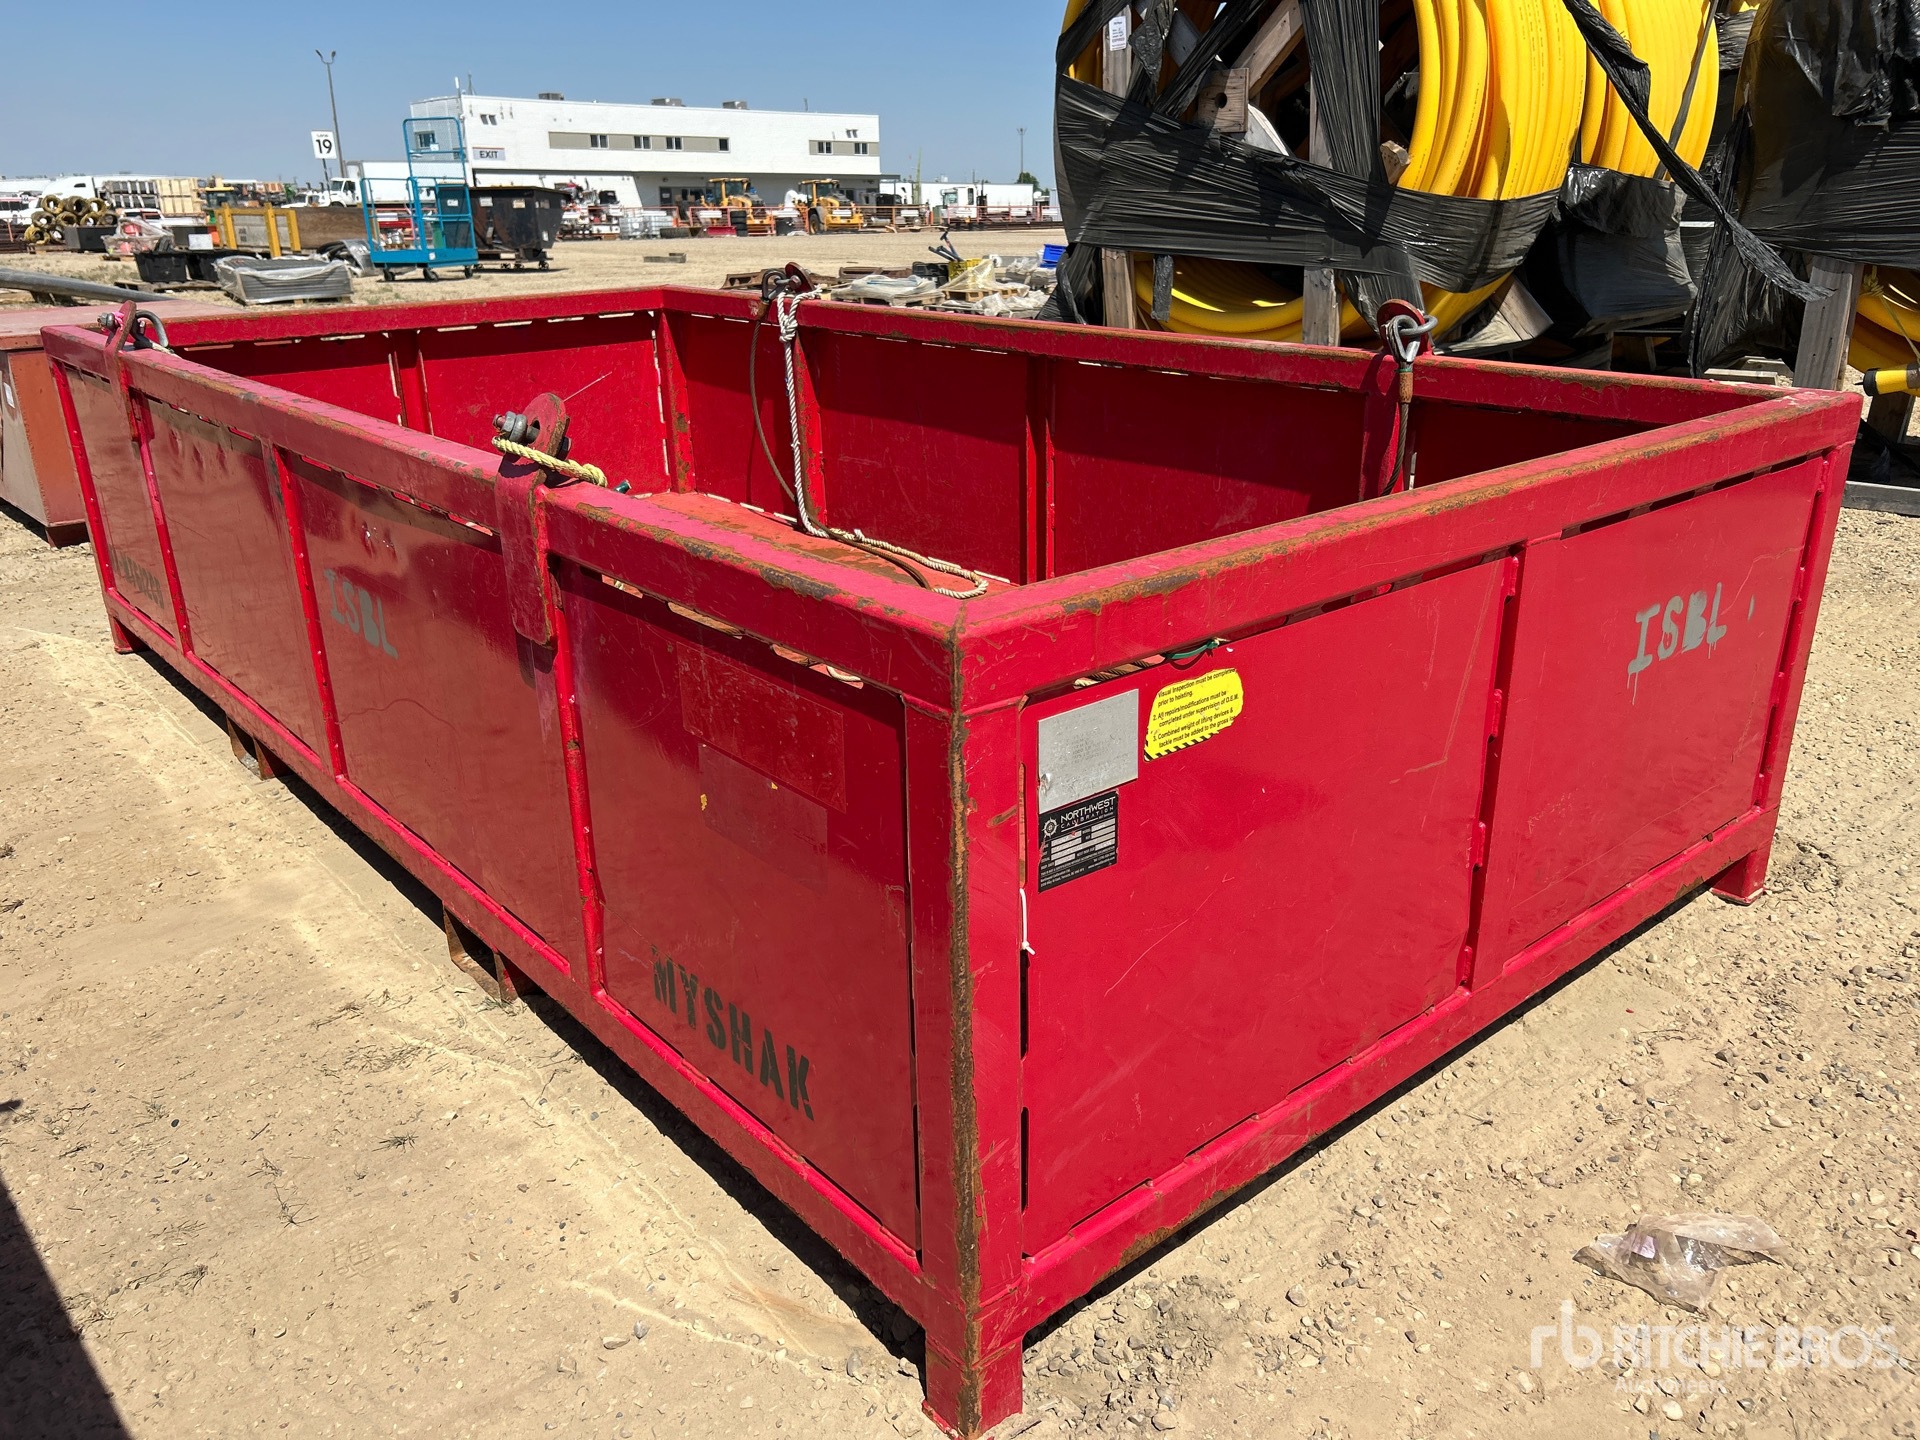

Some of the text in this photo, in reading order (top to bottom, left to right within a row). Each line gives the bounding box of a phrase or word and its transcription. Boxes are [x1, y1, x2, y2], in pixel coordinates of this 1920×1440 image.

[315, 139, 333, 154] 19
[479, 150, 499, 159] EXIT
[324, 568, 399, 660] ISBL
[1627, 582, 1727, 675] ISBL
[1158, 689, 1172, 698] Visual
[1195, 676, 1207, 684] must
[1158, 700, 1169, 708] prior
[1159, 714, 1184, 727] completed
[1183, 710, 1195, 718] under
[1196, 702, 1221, 715] supervision
[1158, 728, 1181, 740] Combined
[1181, 723, 1195, 733] weight
[1201, 716, 1213, 725] lifting
[1213, 710, 1229, 719] devices
[1159, 738, 1172, 747] tackle
[1173, 735, 1184, 743] must
[1191, 728, 1204, 736] added
[1217, 719, 1229, 728] gross
[1061, 796, 1116, 823] NORTHWEST
[1061, 807, 1114, 829] CALIBRATION
[650, 945, 814, 1121] MYSHAK
